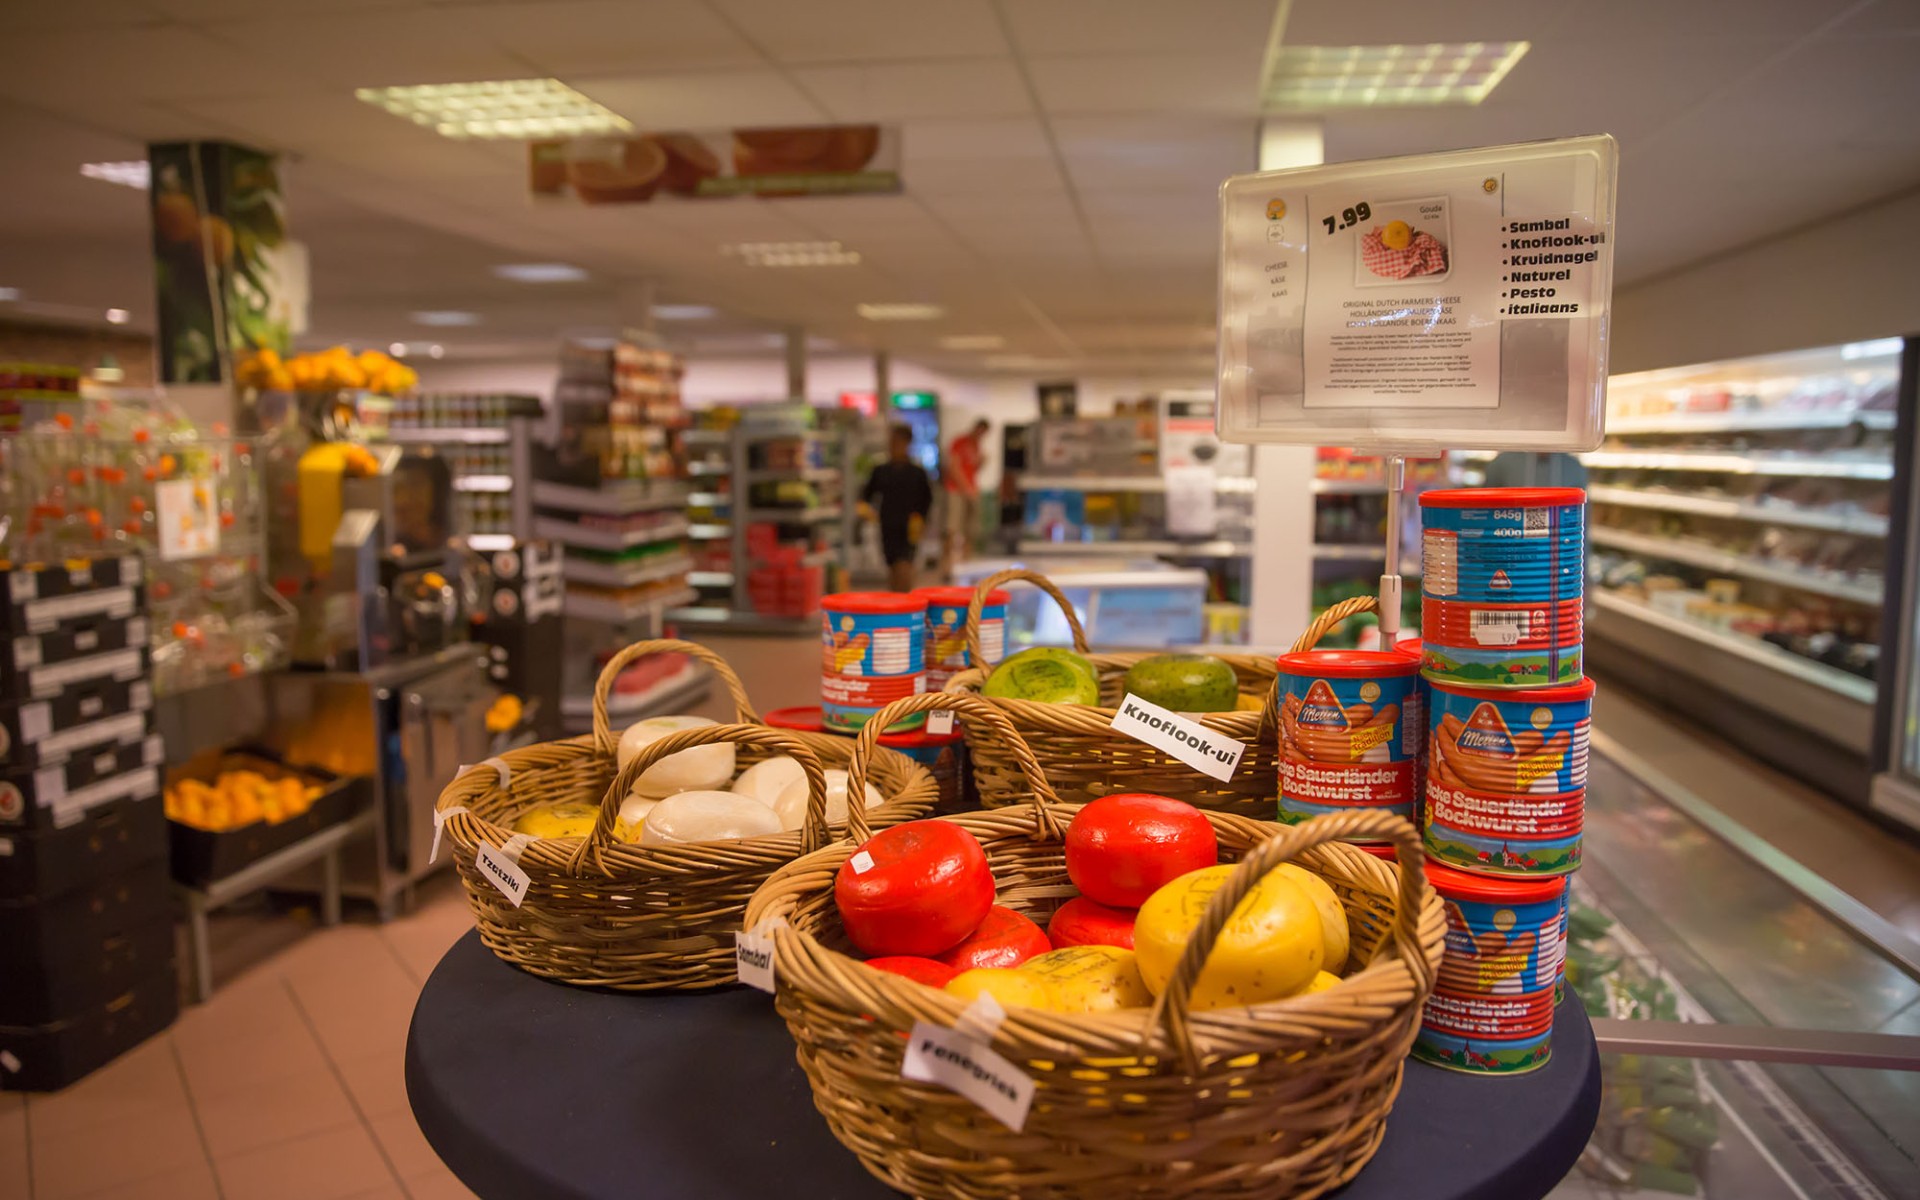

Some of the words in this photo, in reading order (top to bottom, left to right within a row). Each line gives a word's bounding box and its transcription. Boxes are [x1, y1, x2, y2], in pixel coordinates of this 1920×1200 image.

[1419, 204, 1442, 214] Gouda
[1322, 201, 1371, 235] 7.99
[1510, 218, 1570, 233] Sambal
[1511, 232, 1605, 249] Knoflook-ui
[1511, 250, 1598, 266] Kruidnagel
[1511, 269, 1570, 282] Naturel
[1510, 288, 1556, 299] Pesto
[1343, 300, 1374, 308] ORIGINAL
[1376, 299, 1399, 307] DUTCH
[1401, 297, 1433, 305] FARMERS
[1508, 303, 1579, 315] italiaans
[1493, 511, 1522, 521] 845g
[1493, 529, 1522, 537] 400g
[1123, 703, 1237, 766] Knoflook-ui
[1296, 764, 1399, 785] Sauerländer
[1283, 775, 1372, 801] Bockwurst
[1452, 790, 1566, 817] Sauerländer
[1434, 801, 1538, 833] Bockwurst
[482, 854, 520, 893] Tzatziki
